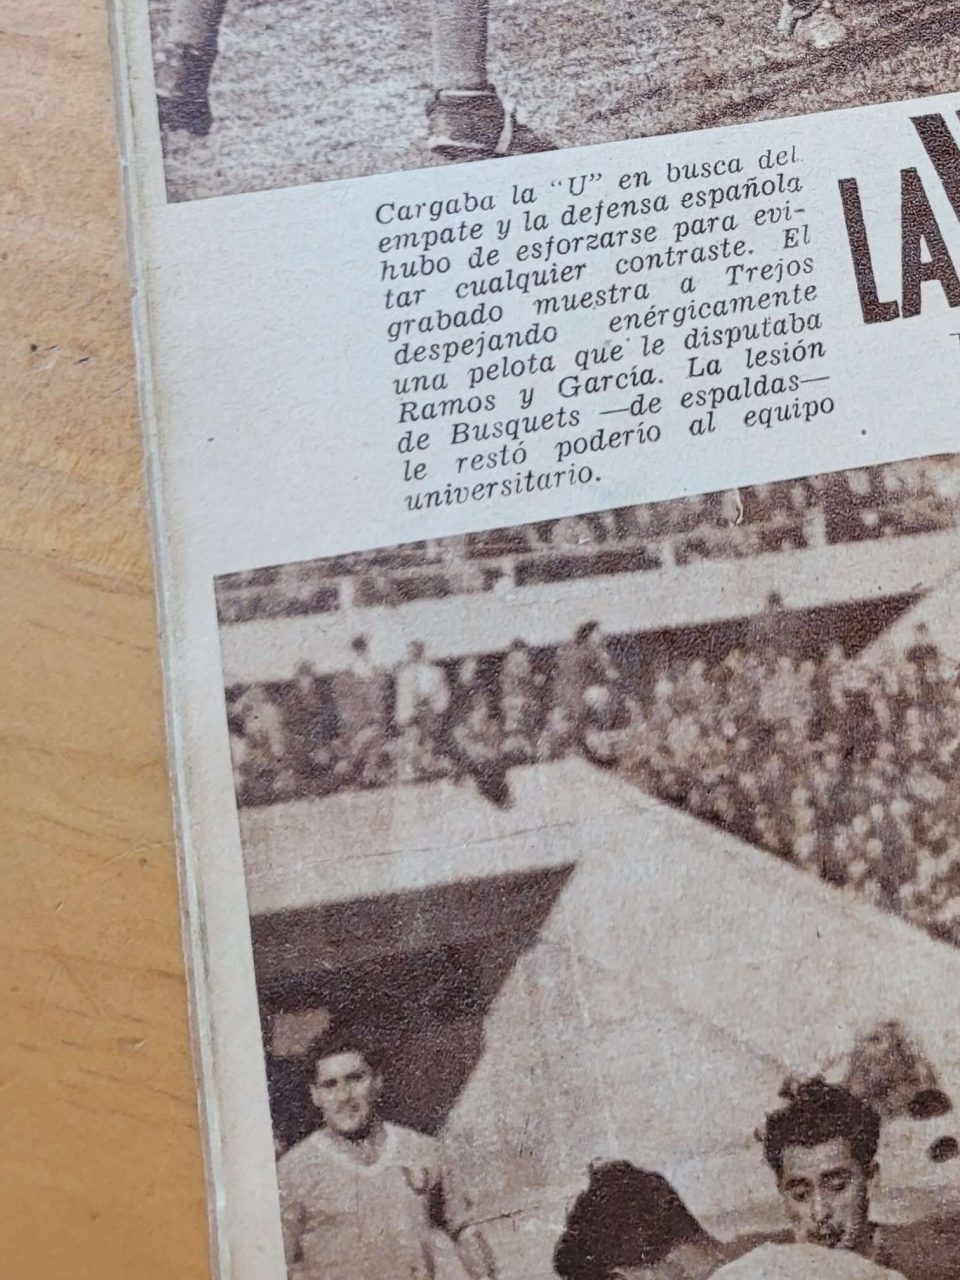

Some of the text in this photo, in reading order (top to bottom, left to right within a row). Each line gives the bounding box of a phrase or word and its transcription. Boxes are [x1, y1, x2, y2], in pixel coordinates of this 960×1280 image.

[375, 192, 496, 224] Cargaba
[513, 185, 537, 205] la
[618, 171, 652, 190] en
[666, 158, 744, 182] busca
[758, 145, 799, 169] del
[378, 173, 803, 253] empate y la defensa española
[380, 200, 805, 281] hubo de esforzarse para evi-
[384, 224, 811, 309] tar cualquier contraste. El
[387, 257, 813, 342] grabado muestra a Trejos
[394, 284, 817, 365] despejando enérgicamente
[392, 313, 822, 395] una pelota que le disputaba
[398, 339, 827, 423] Ramos y García. La lesión
[398, 431, 430, 454] de
[450, 407, 580, 445] Busquets
[404, 397, 834, 482] le restó poderío al equipo
[404, 466, 601, 511] universitario.
